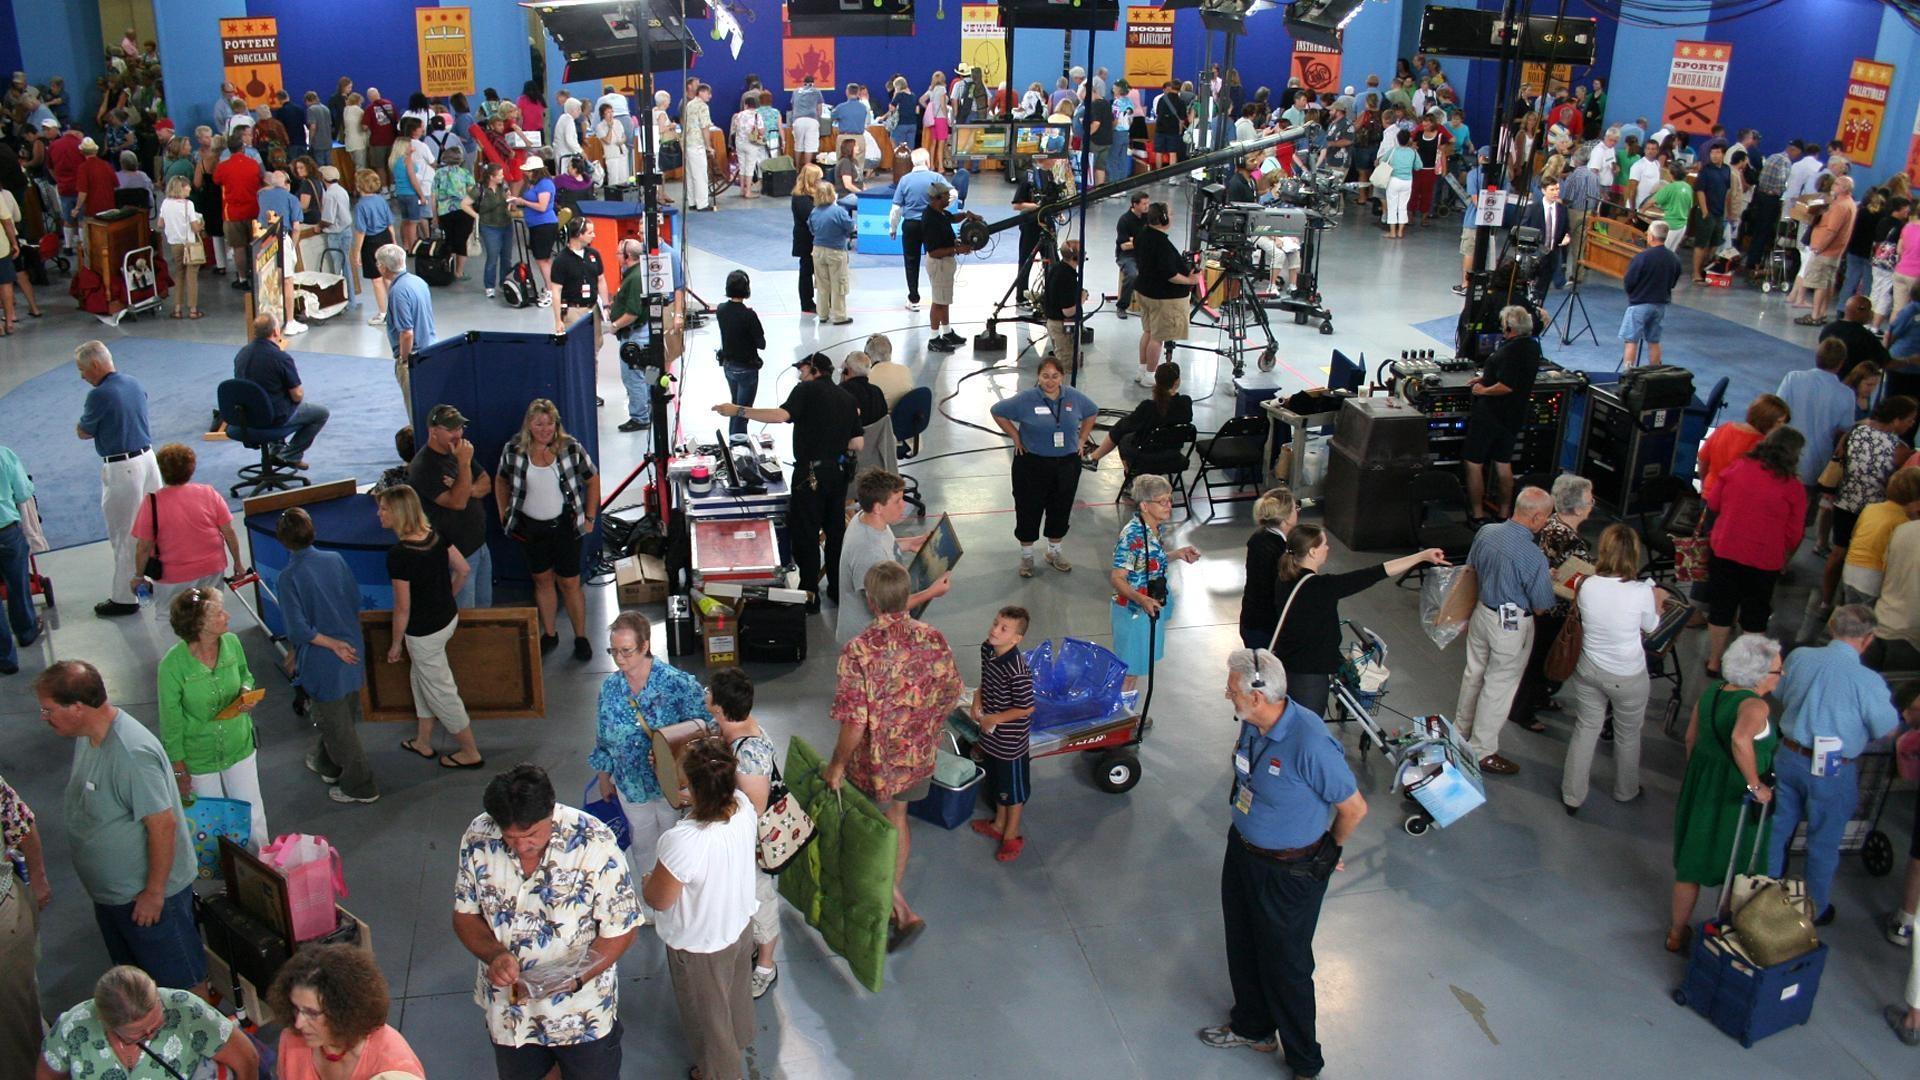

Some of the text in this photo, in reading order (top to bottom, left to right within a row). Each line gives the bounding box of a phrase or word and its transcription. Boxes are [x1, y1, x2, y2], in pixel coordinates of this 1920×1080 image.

[963, 23, 1006, 33] JEWELR
[224, 38, 276, 50] POTTERY
[1139, 33, 1172, 45] MANUSCRIPTS
[1296, 40, 1339, 53] INSTRUME
[233, 52, 278, 64] PORCELAIN
[427, 53, 468, 68] ANTIQUES
[1674, 61, 1725, 72] SPORTS
[427, 68, 467, 82] ROADSHOW
[1670, 72, 1721, 89] MEMORABILIA
[1849, 83, 1887, 101] COLLECTIBLES
